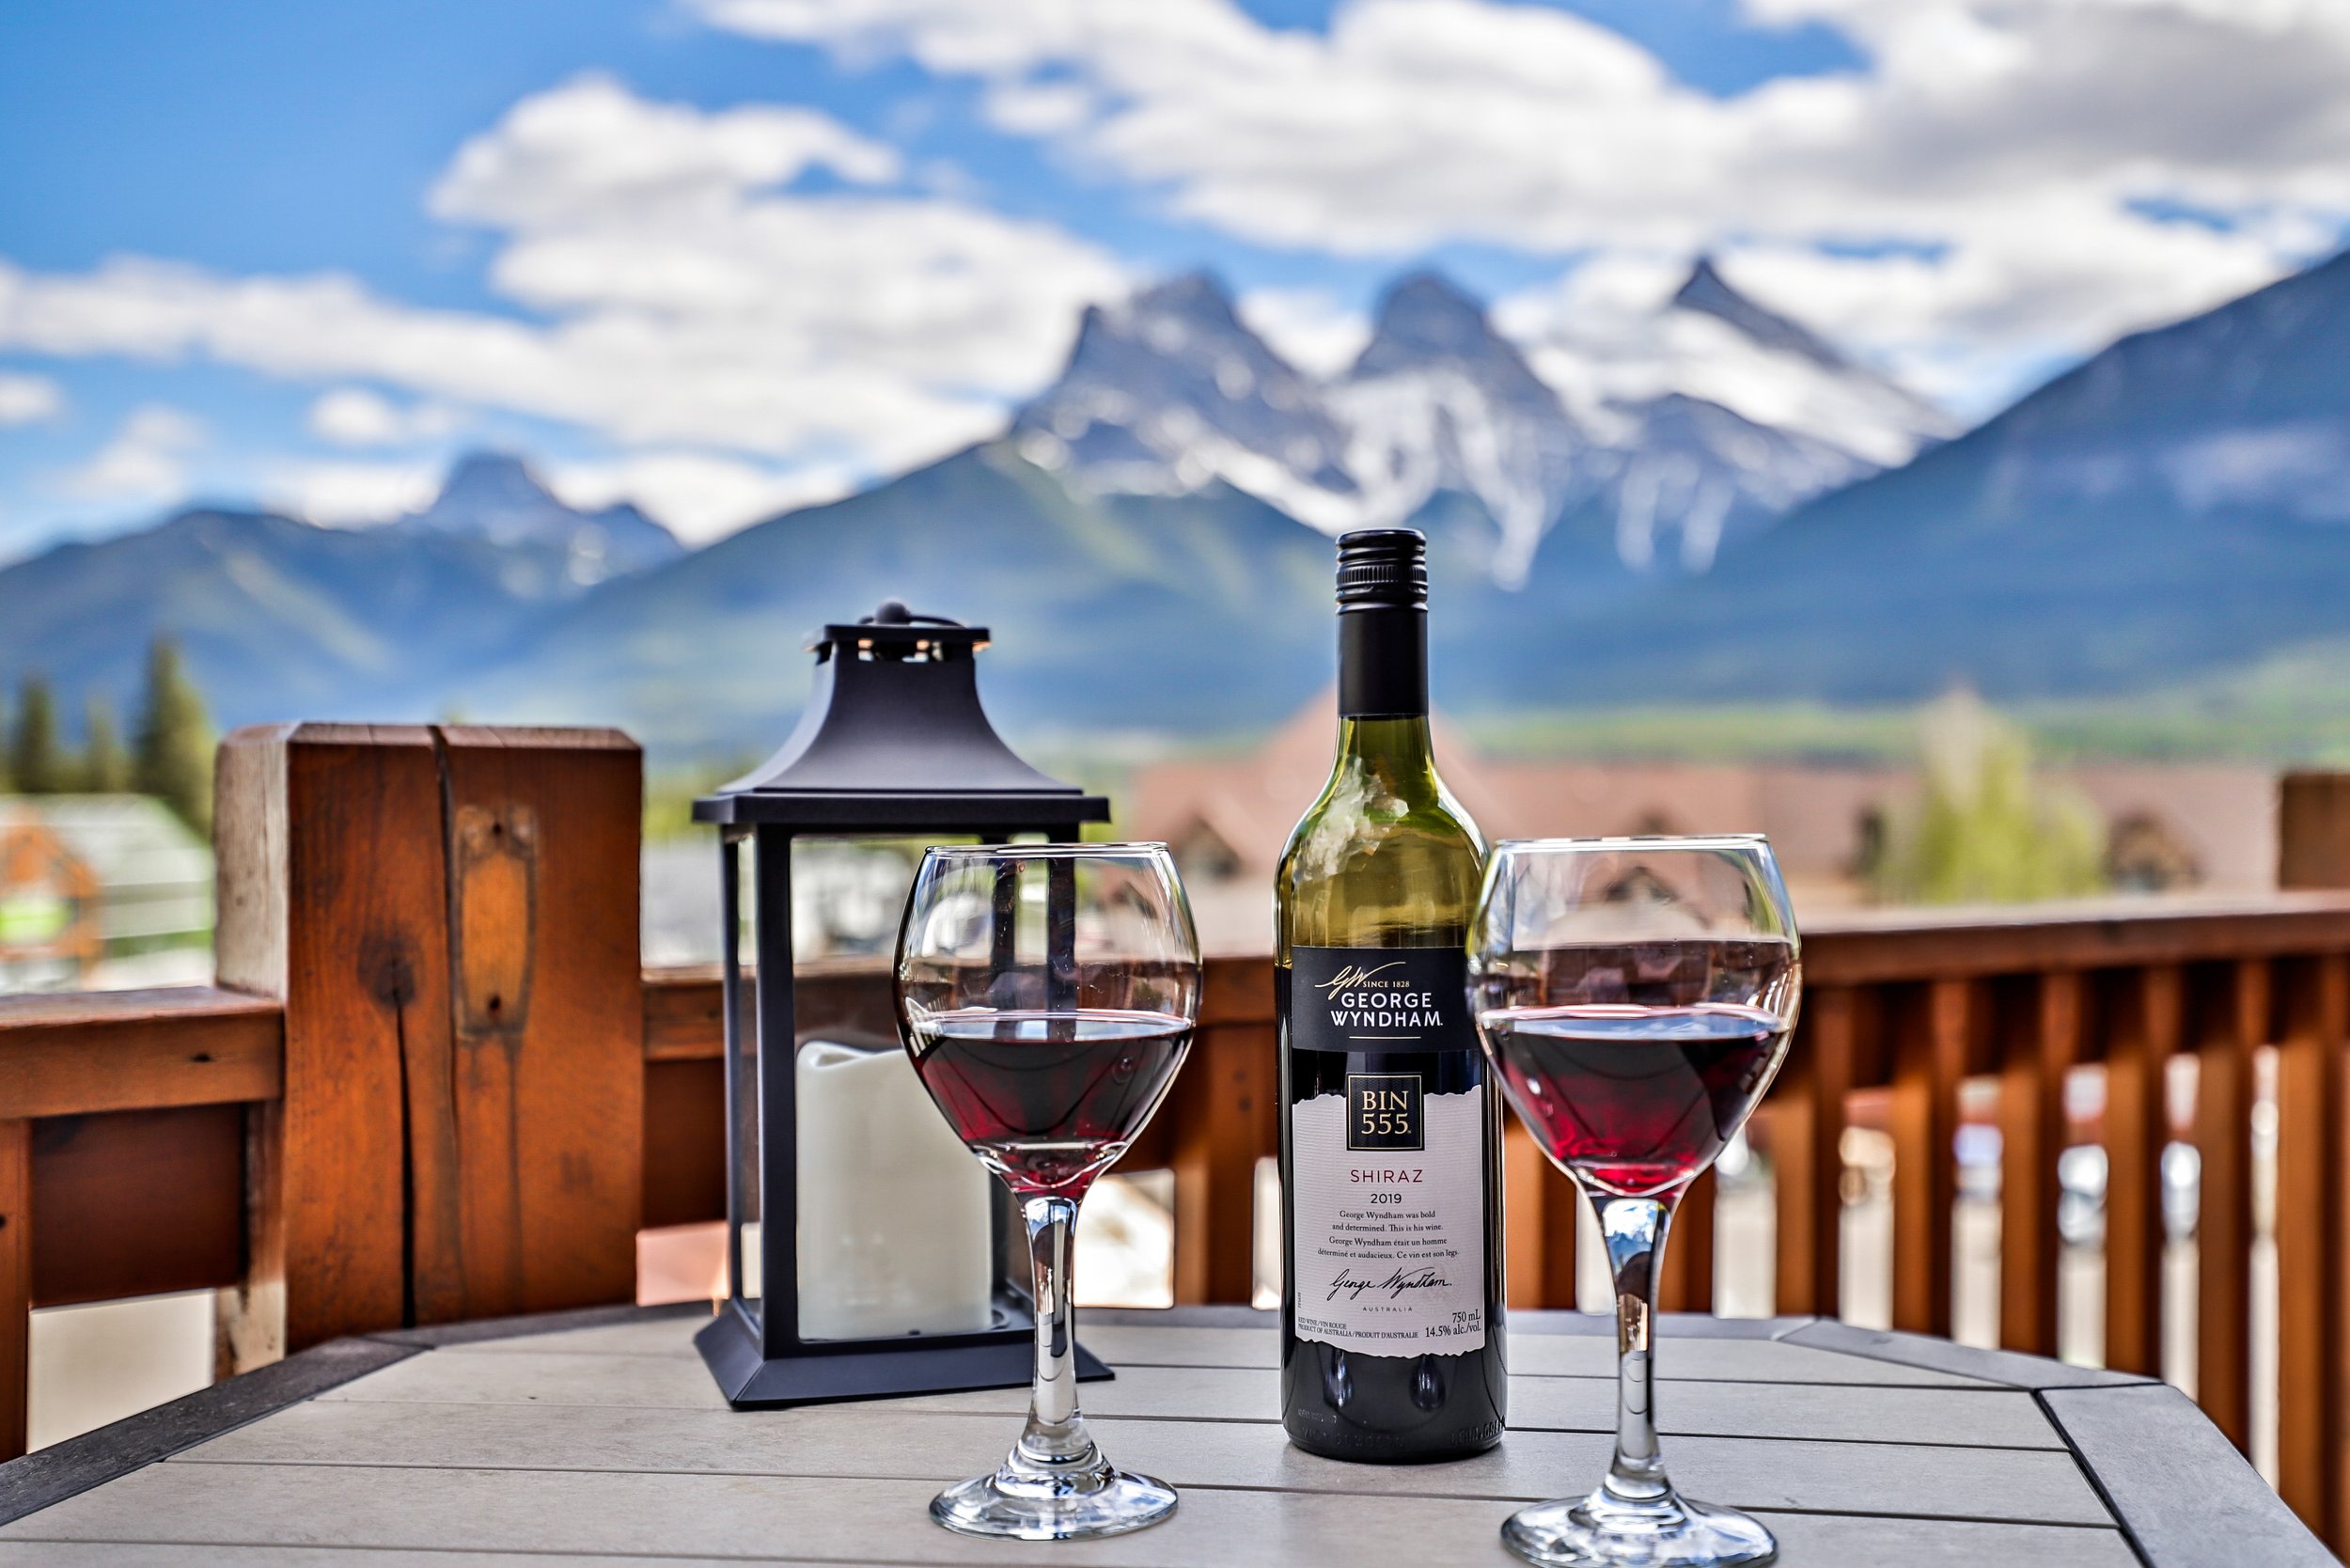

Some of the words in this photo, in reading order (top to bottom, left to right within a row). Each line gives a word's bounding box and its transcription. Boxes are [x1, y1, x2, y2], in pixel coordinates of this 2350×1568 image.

[1340, 993, 1432, 1009] GEORGE
[1362, 1090, 1409, 1111] BIN
[1350, 1169, 1423, 1183] SHIRAZ
[1371, 1193, 1402, 1204] 2019
[1340, 1210, 1365, 1220] George
[1366, 1211, 1404, 1221] Wyndham
[1420, 1210, 1435, 1218] bold
[1345, 1223, 1386, 1231] determined.
[1328, 1235, 1353, 1247] George
[1354, 1237, 1392, 1247] Wyndham
[1421, 1237, 1447, 1246] homme
[1326, 1268, 1376, 1301] George
[1452, 1310, 1466, 1324] 750
[1468, 1308, 1481, 1321] mL
[1328, 1322, 1347, 1330] ROUGE
[1425, 1325, 1451, 1338] 14.5%
